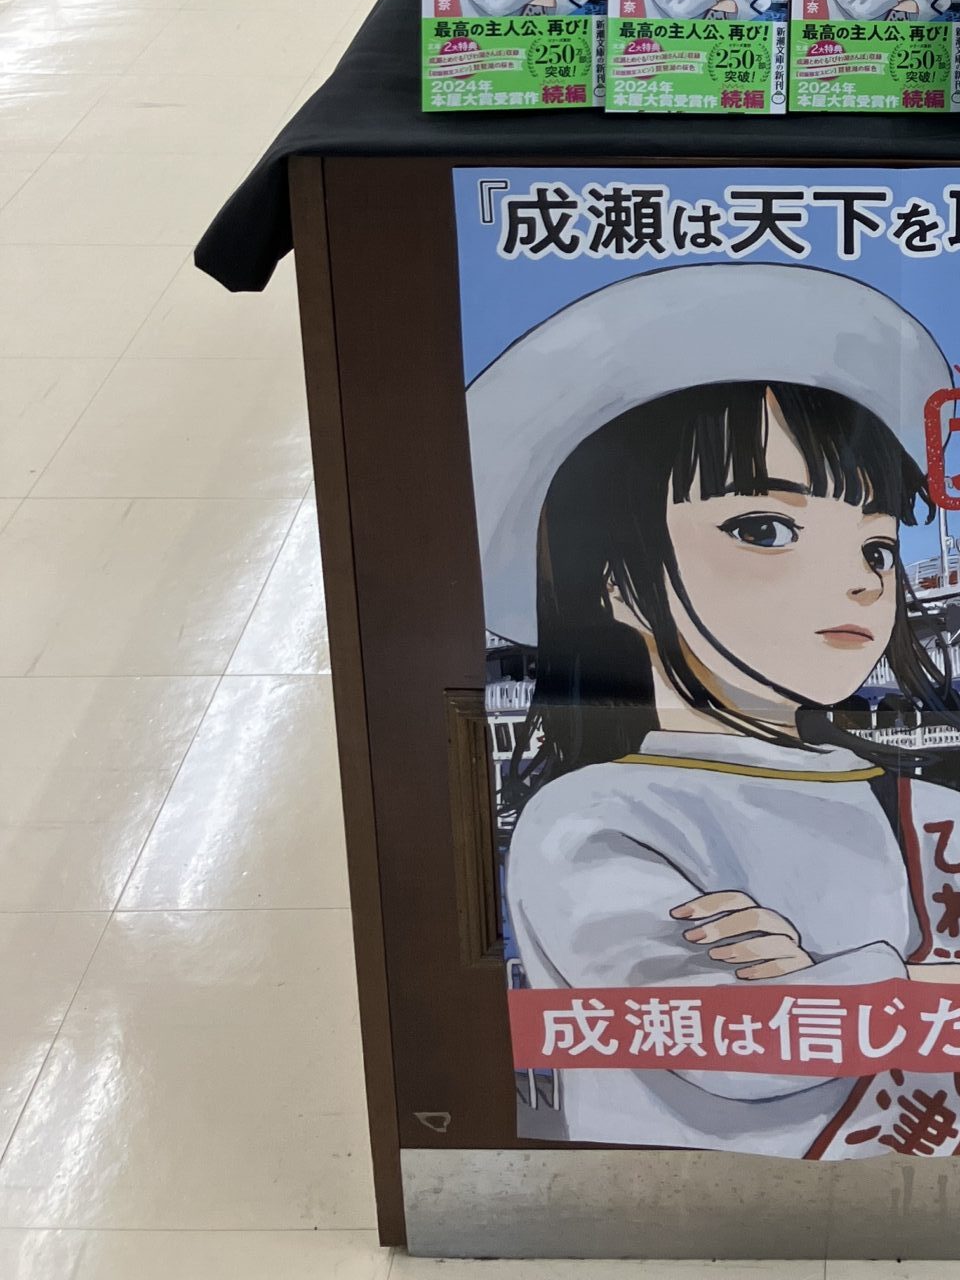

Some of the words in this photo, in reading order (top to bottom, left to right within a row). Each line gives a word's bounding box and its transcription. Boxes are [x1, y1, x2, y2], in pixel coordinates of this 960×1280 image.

[434, 19, 589, 38] 最高の主人公、再び!
[619, 21, 769, 42] 最高の主人公、再び!
[802, 24, 949, 42] 最高の主人公、再び!
[545, 66, 577, 78] 突破!
[724, 71, 756, 83] 突破!
[906, 71, 935, 84] 突破!
[431, 80, 493, 93] 2024年
[614, 81, 674, 94] 2024年
[798, 82, 857, 94] 2024年
[542, 84, 587, 105] 続編
[720, 89, 765, 110] 続編
[902, 89, 945, 110] 続編
